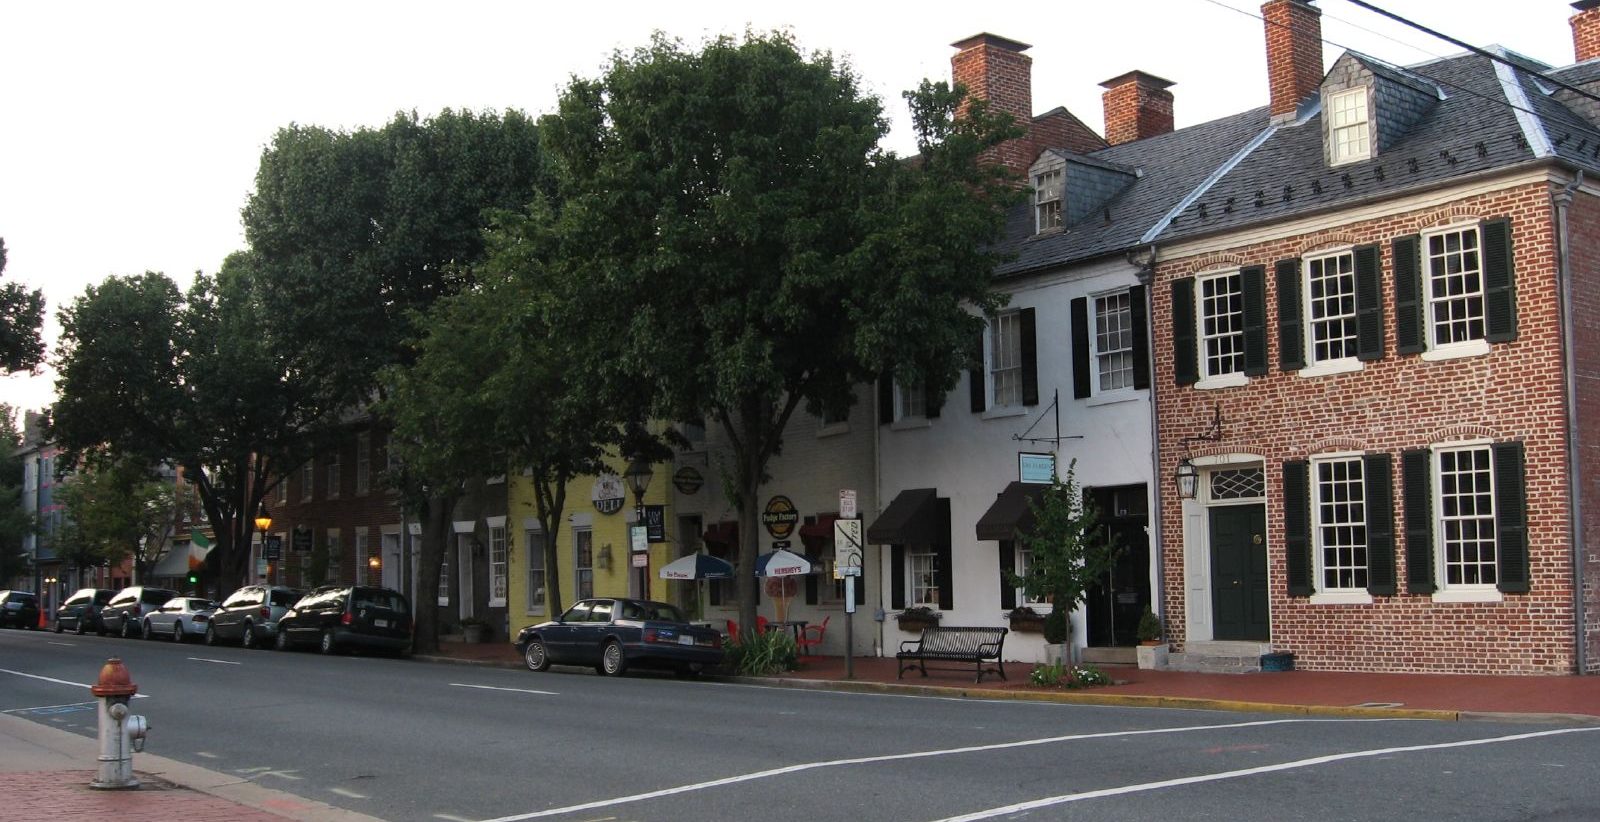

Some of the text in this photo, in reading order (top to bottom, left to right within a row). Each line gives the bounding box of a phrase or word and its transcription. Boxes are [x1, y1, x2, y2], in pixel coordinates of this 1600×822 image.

[1214, 454, 1230, 464] 701
[597, 500, 619, 512] DELI
[764, 512, 797, 522] Fudge Factory
[774, 566, 802, 575] HERSHEY'S
